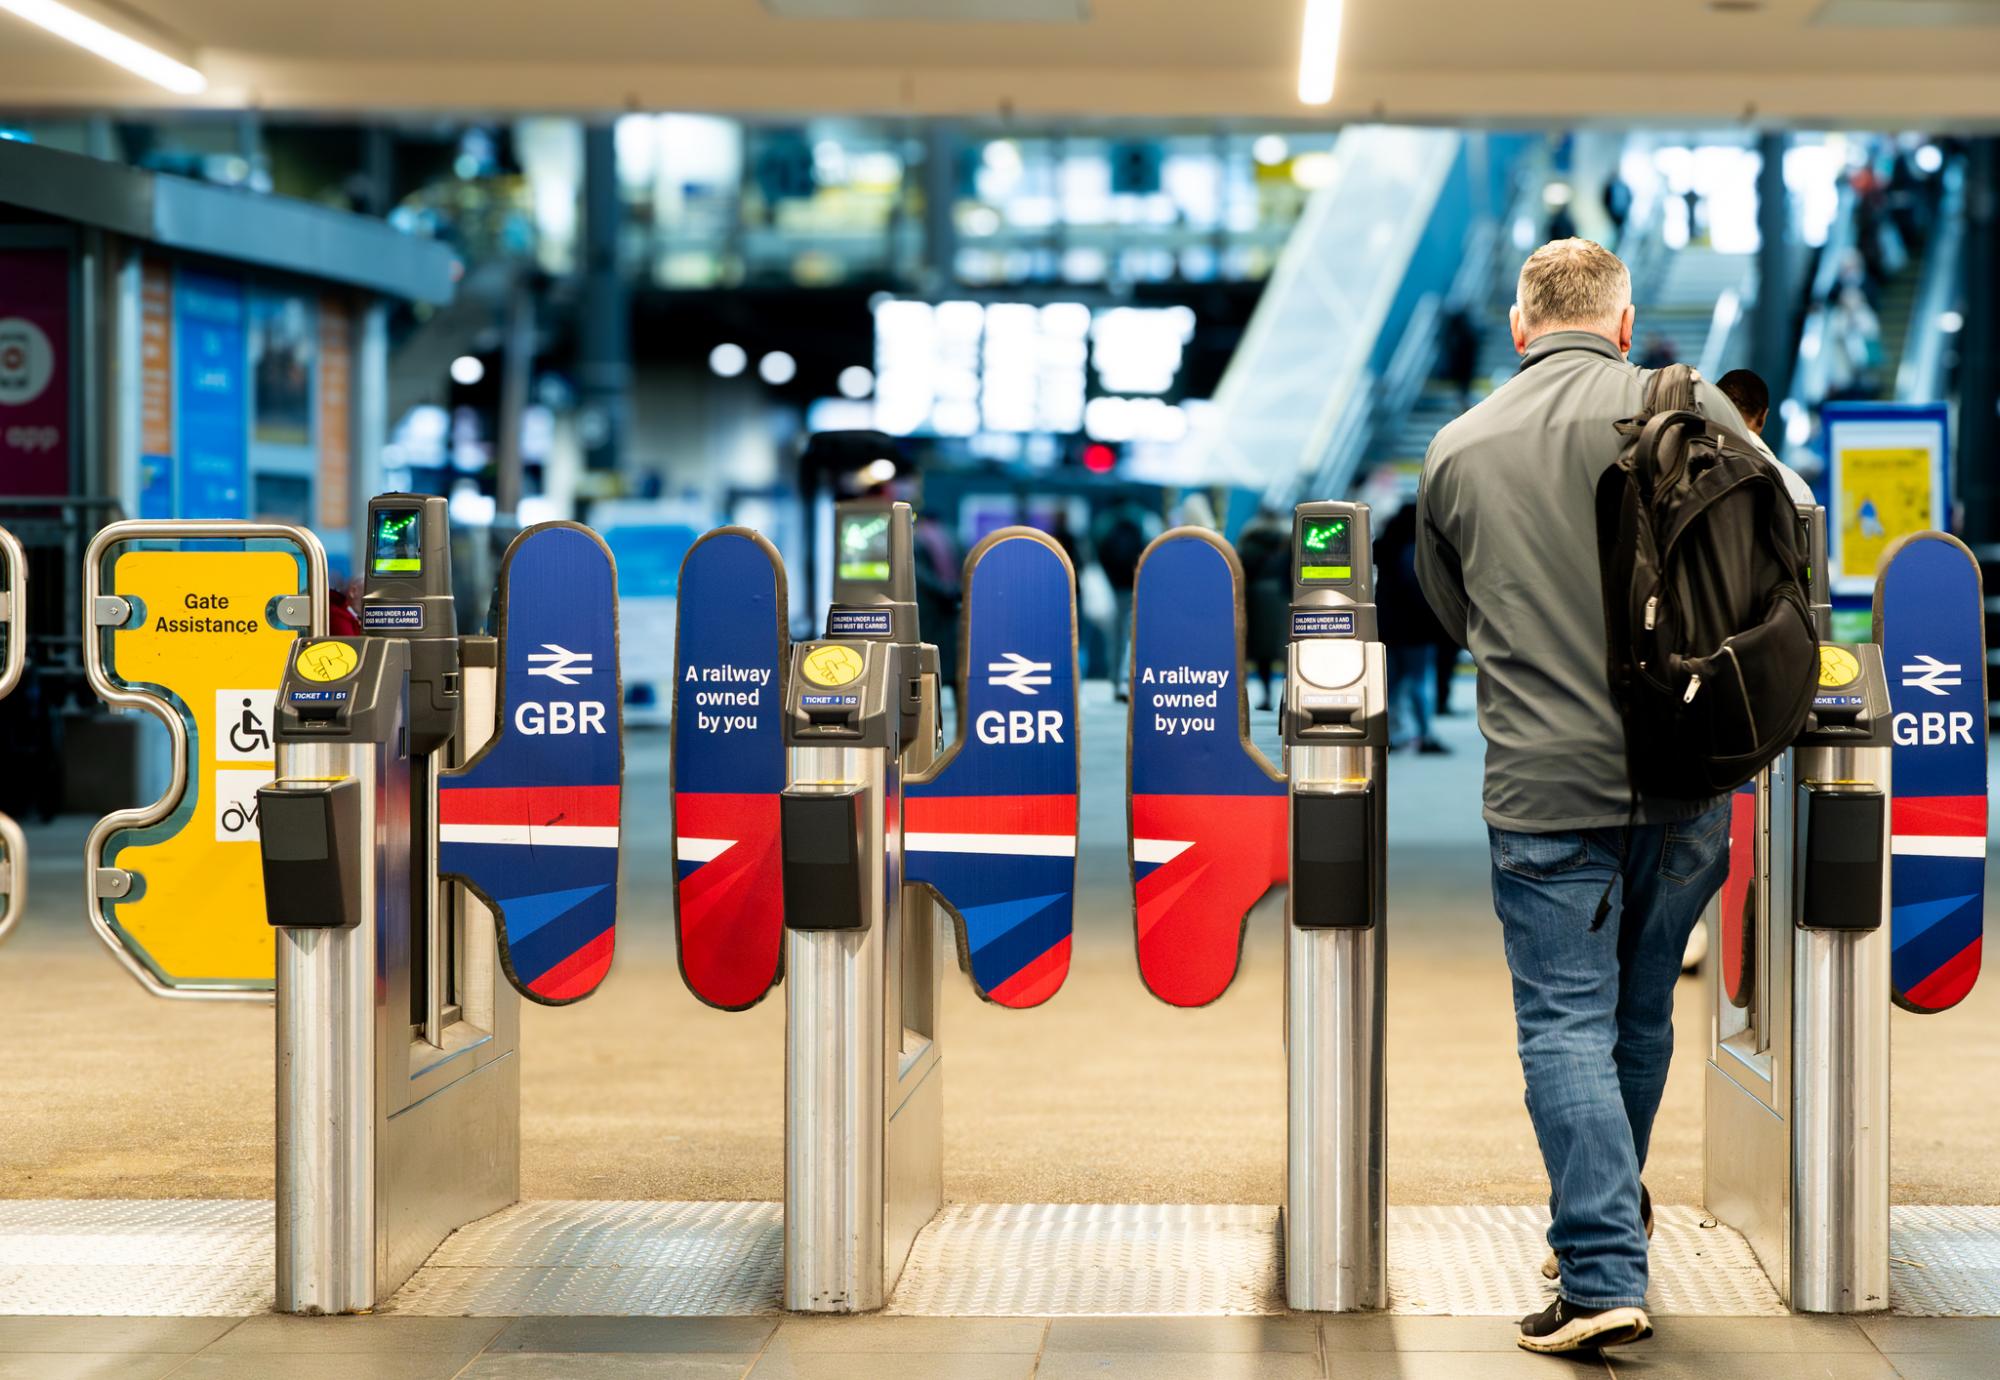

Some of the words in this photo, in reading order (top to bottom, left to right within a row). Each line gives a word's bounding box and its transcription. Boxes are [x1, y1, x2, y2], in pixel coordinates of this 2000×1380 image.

[184, 593, 229, 609] Gate
[155, 616, 258, 633] Assistance
[685, 665, 698, 681] A
[703, 664, 771, 686] railway
[1142, 667, 1156, 684] A
[1159, 666, 1229, 688] railway
[696, 688, 759, 706] owned
[845, 696, 857, 704] 52
[1153, 690, 1217, 707] owned
[515, 701, 607, 735] GBR
[698, 712, 720, 733] by
[723, 716, 757, 733] you
[976, 710, 1064, 744] GBR
[1155, 713, 1177, 735] by
[1181, 718, 1215, 735] you
[1892, 712, 1975, 746] GBR
